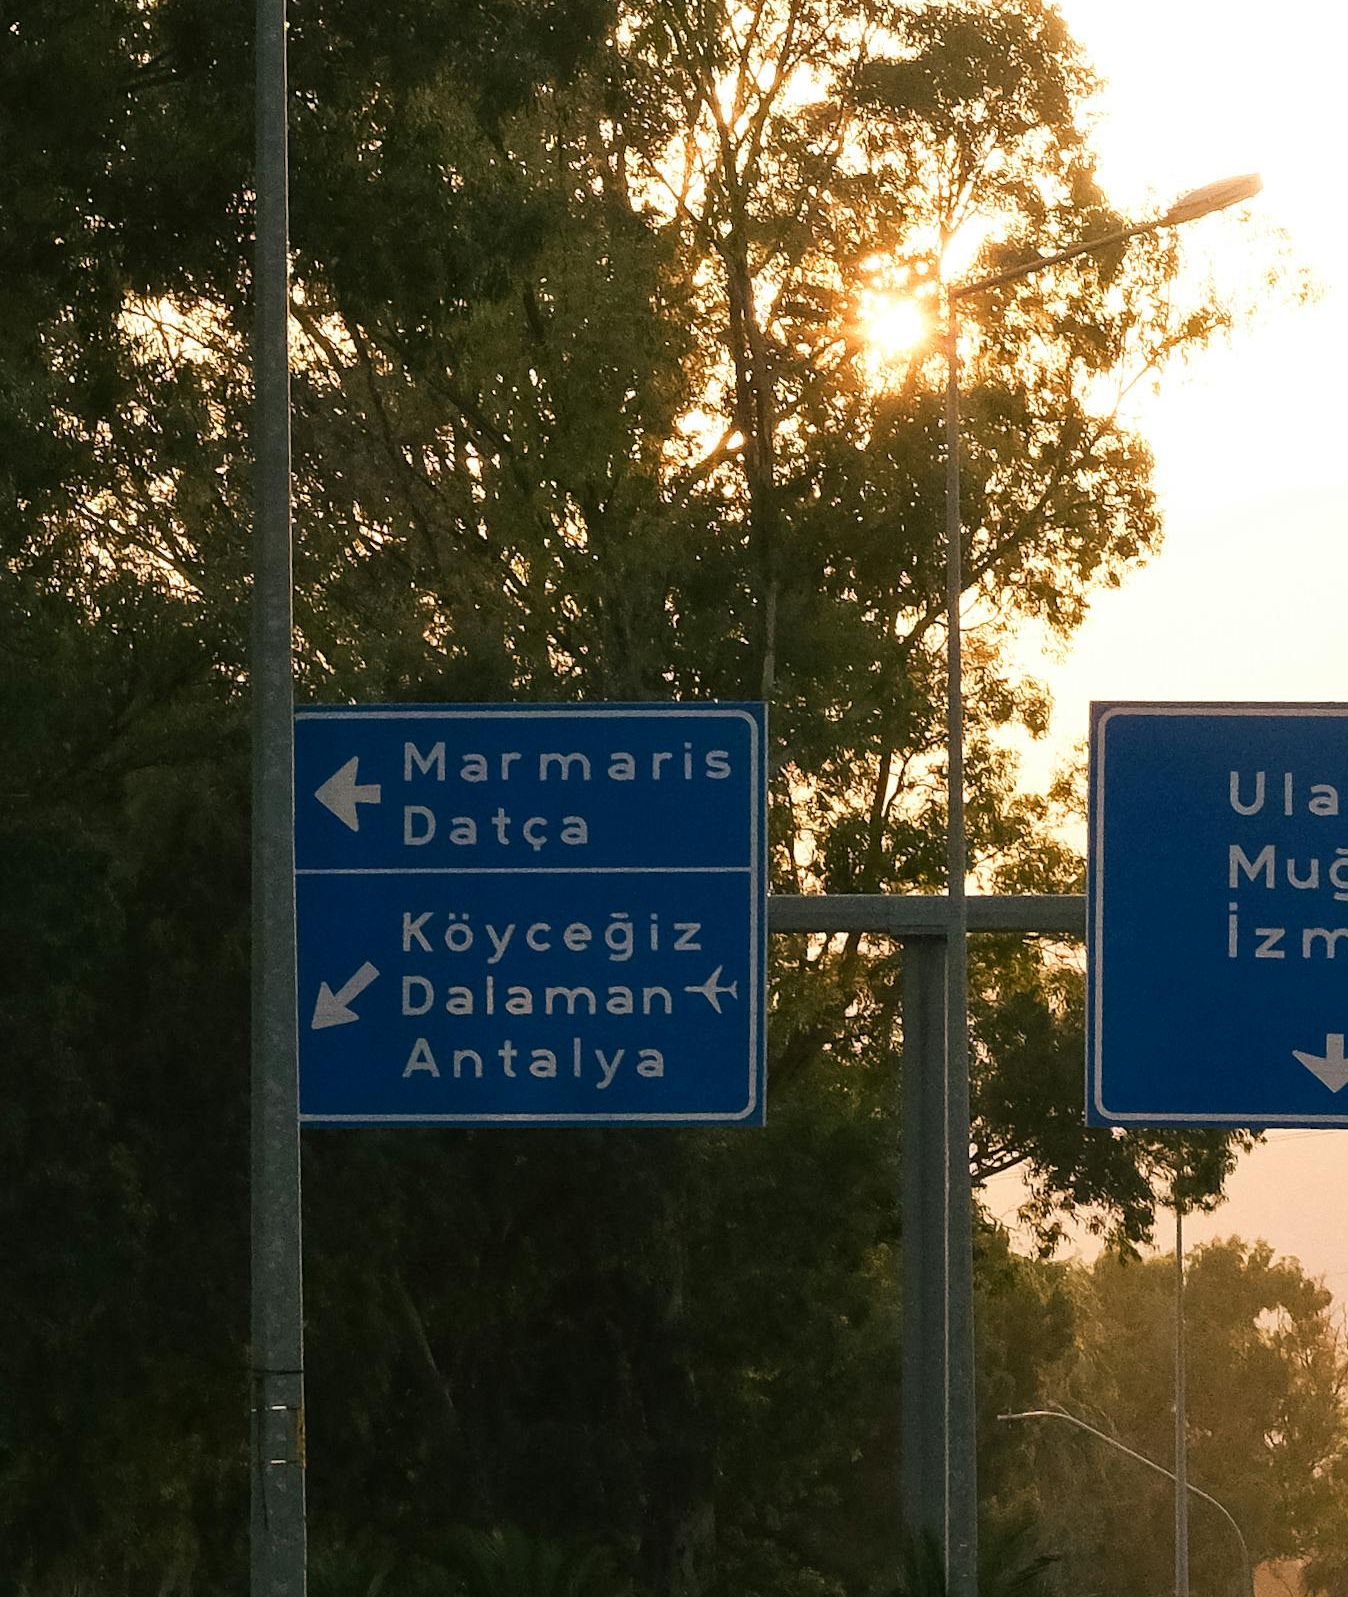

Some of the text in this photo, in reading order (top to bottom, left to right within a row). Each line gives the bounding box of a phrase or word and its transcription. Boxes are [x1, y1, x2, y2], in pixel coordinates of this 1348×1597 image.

[403, 741, 733, 783] Marmaris
[1229, 770, 1340, 817] Ula
[403, 805, 589, 852] Datça
[401, 911, 702, 965] Köyceğiz
[401, 975, 674, 1016] Dalaman
[402, 1037, 666, 1090] Antalya
